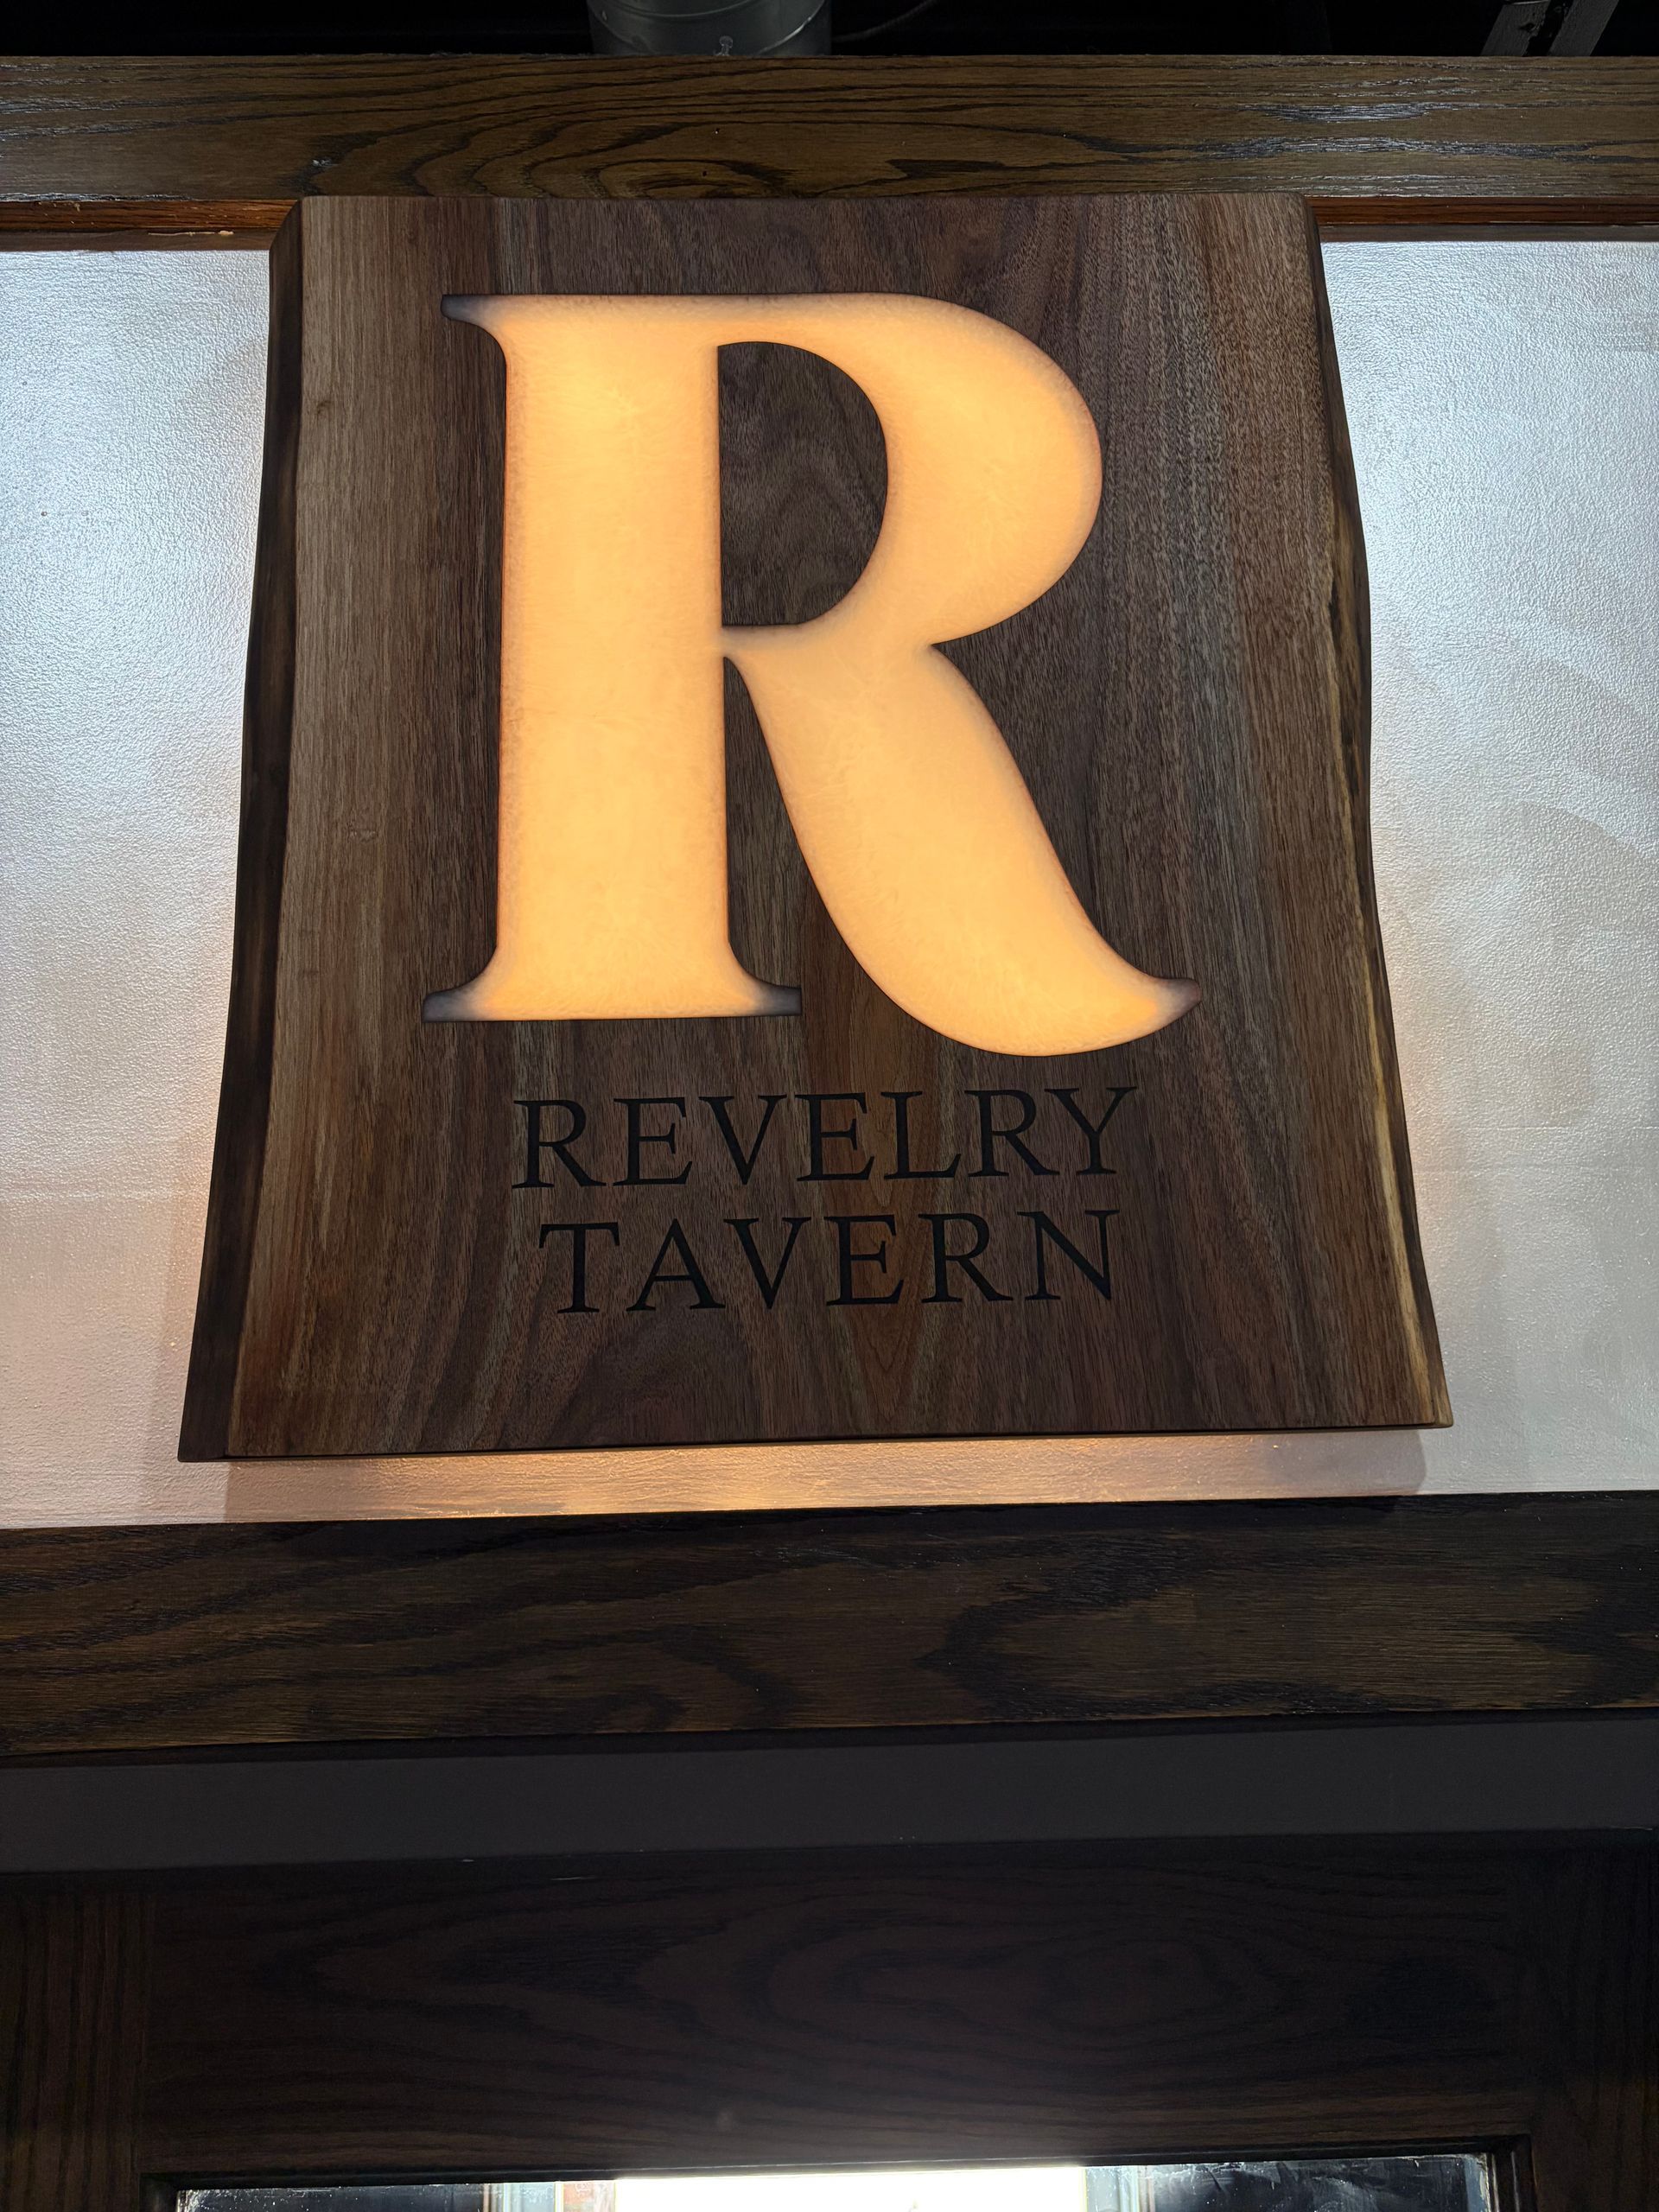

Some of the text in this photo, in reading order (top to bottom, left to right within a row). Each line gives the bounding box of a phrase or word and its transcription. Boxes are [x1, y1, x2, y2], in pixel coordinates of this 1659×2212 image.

[423, 291, 1202, 1057] R
[511, 1086, 1137, 1189] REVELRY
[538, 1210, 1121, 1313] TAVERN
